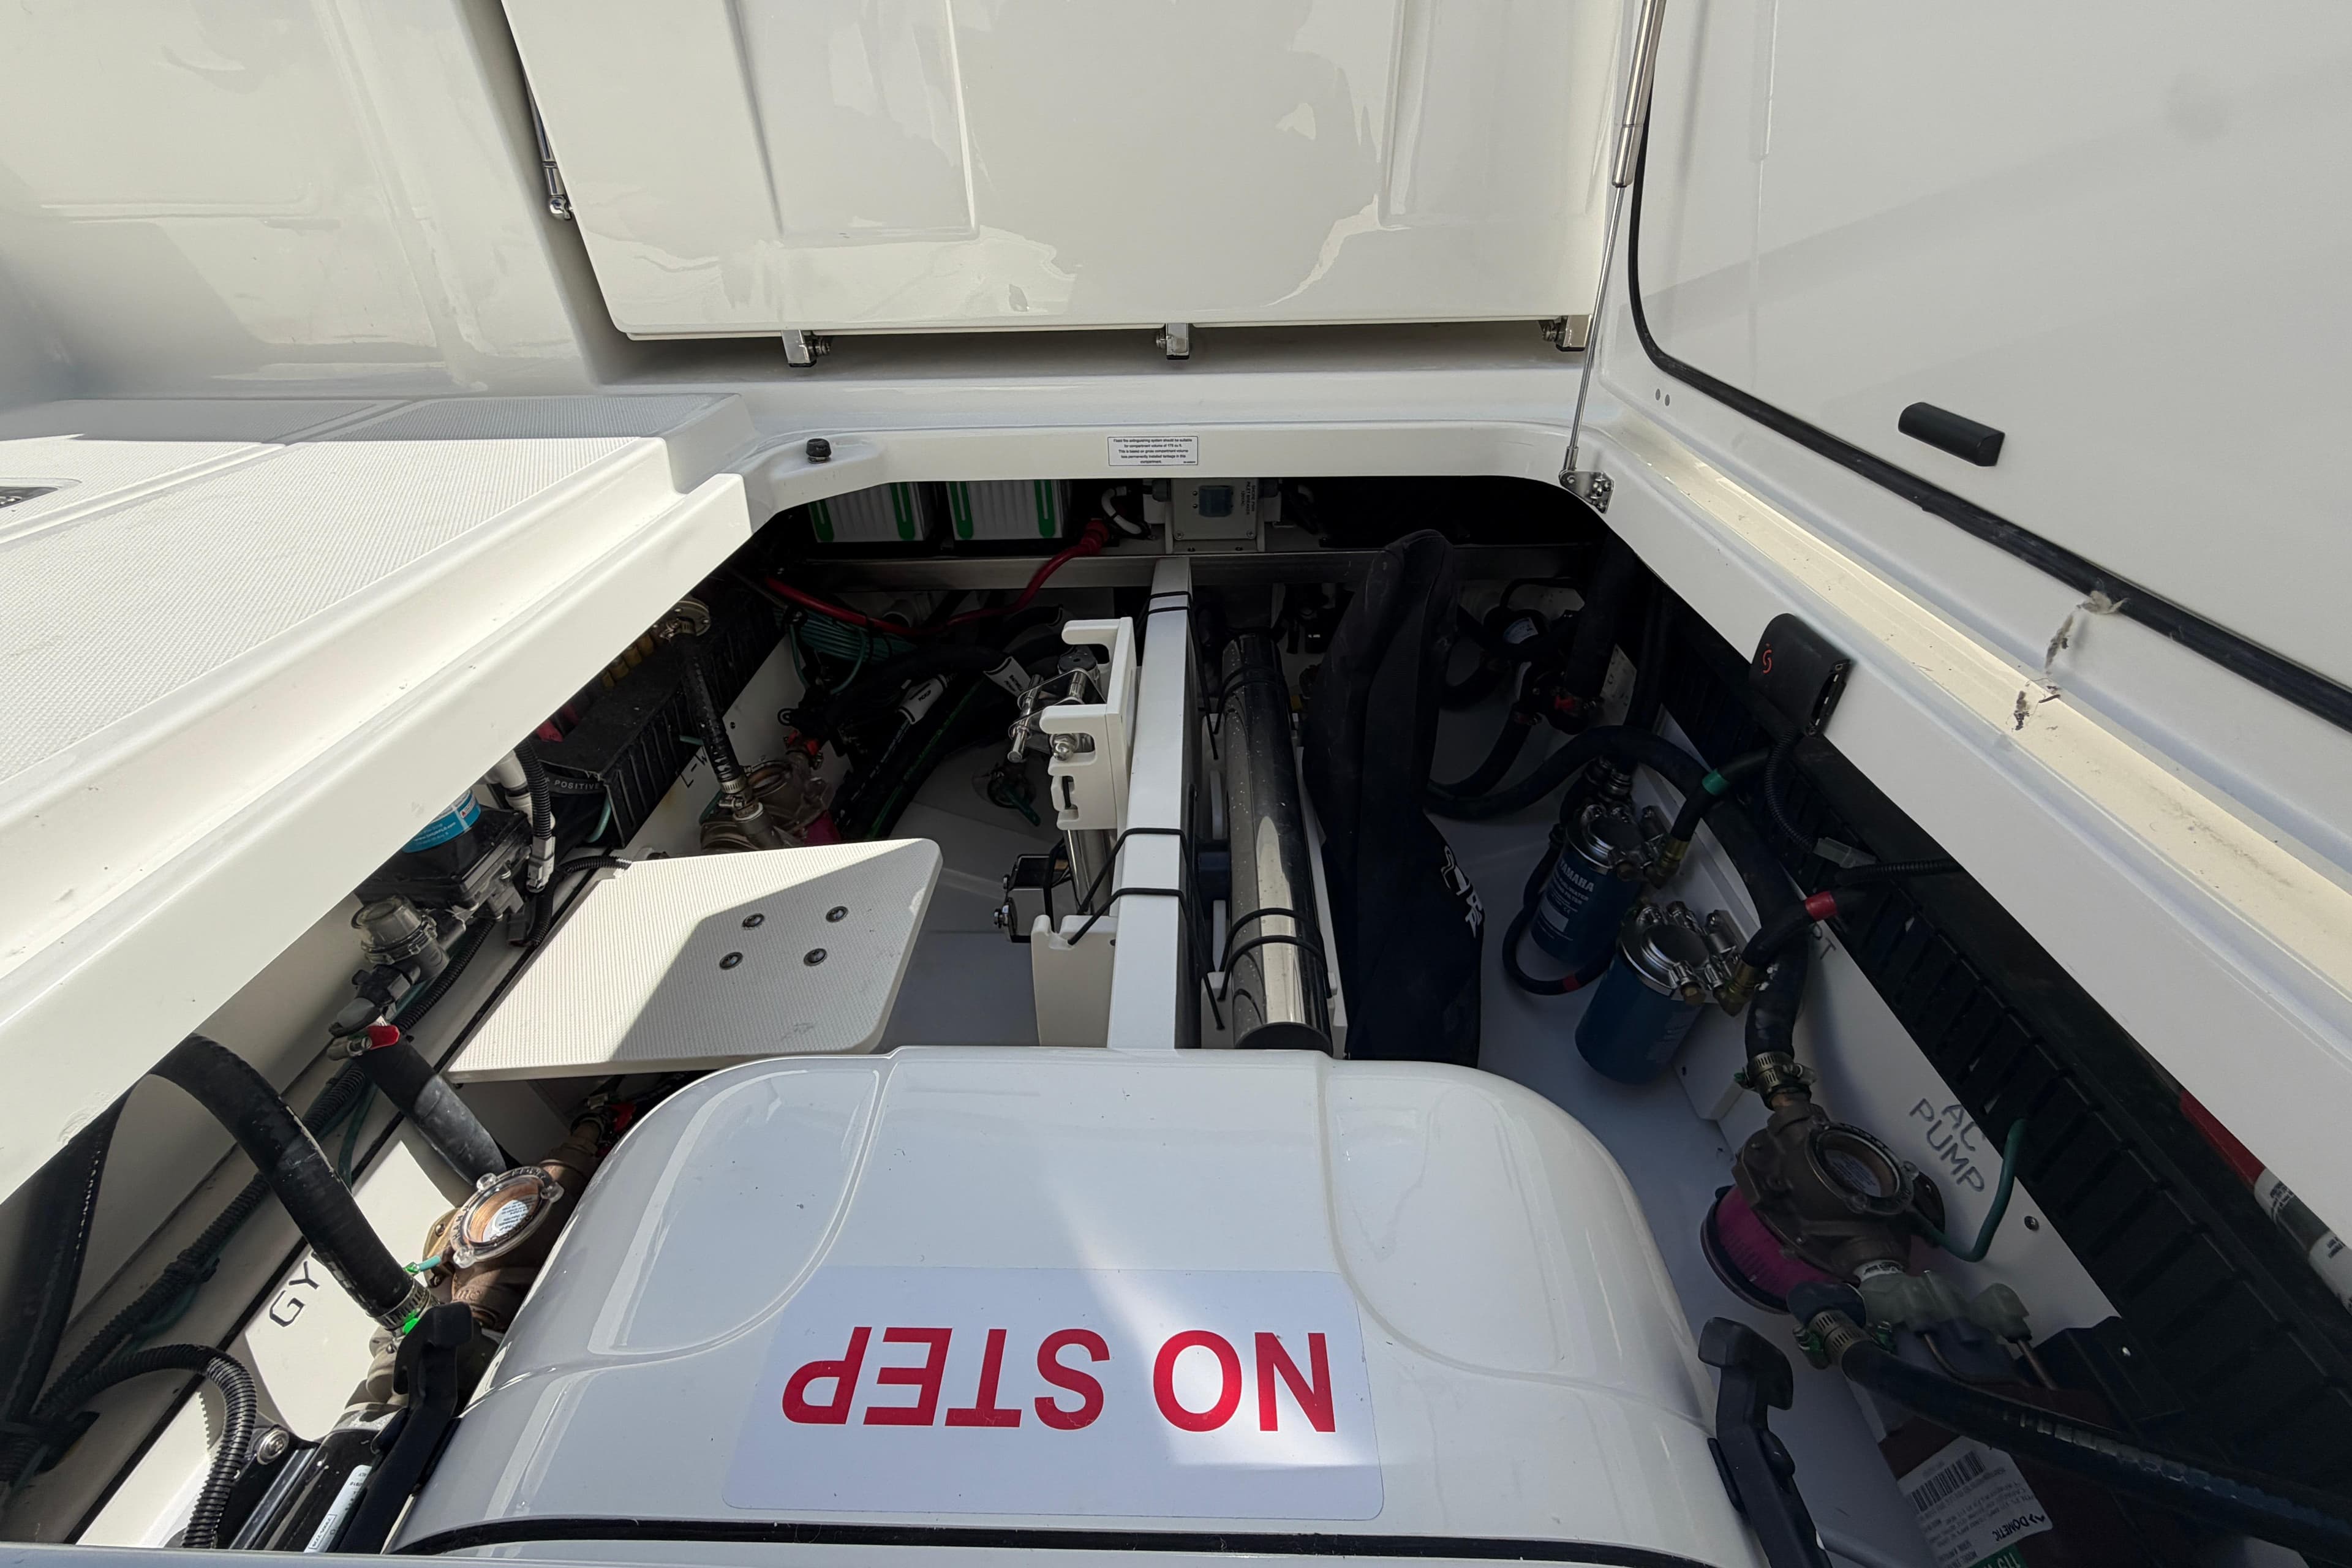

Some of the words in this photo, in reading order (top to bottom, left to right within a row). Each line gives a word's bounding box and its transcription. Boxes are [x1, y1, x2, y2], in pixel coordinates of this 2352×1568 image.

[553, 777, 600, 791] POSITIVE
[1559, 858, 1594, 892] YAMAHA
[1909, 1098, 1986, 1193] PUMP
[1942, 1104, 1986, 1152] AC
[782, 1326, 1112, 1431] STEP
[1153, 1329, 1336, 1433] NO
[1992, 1515, 2030, 1542] DOMETIC
